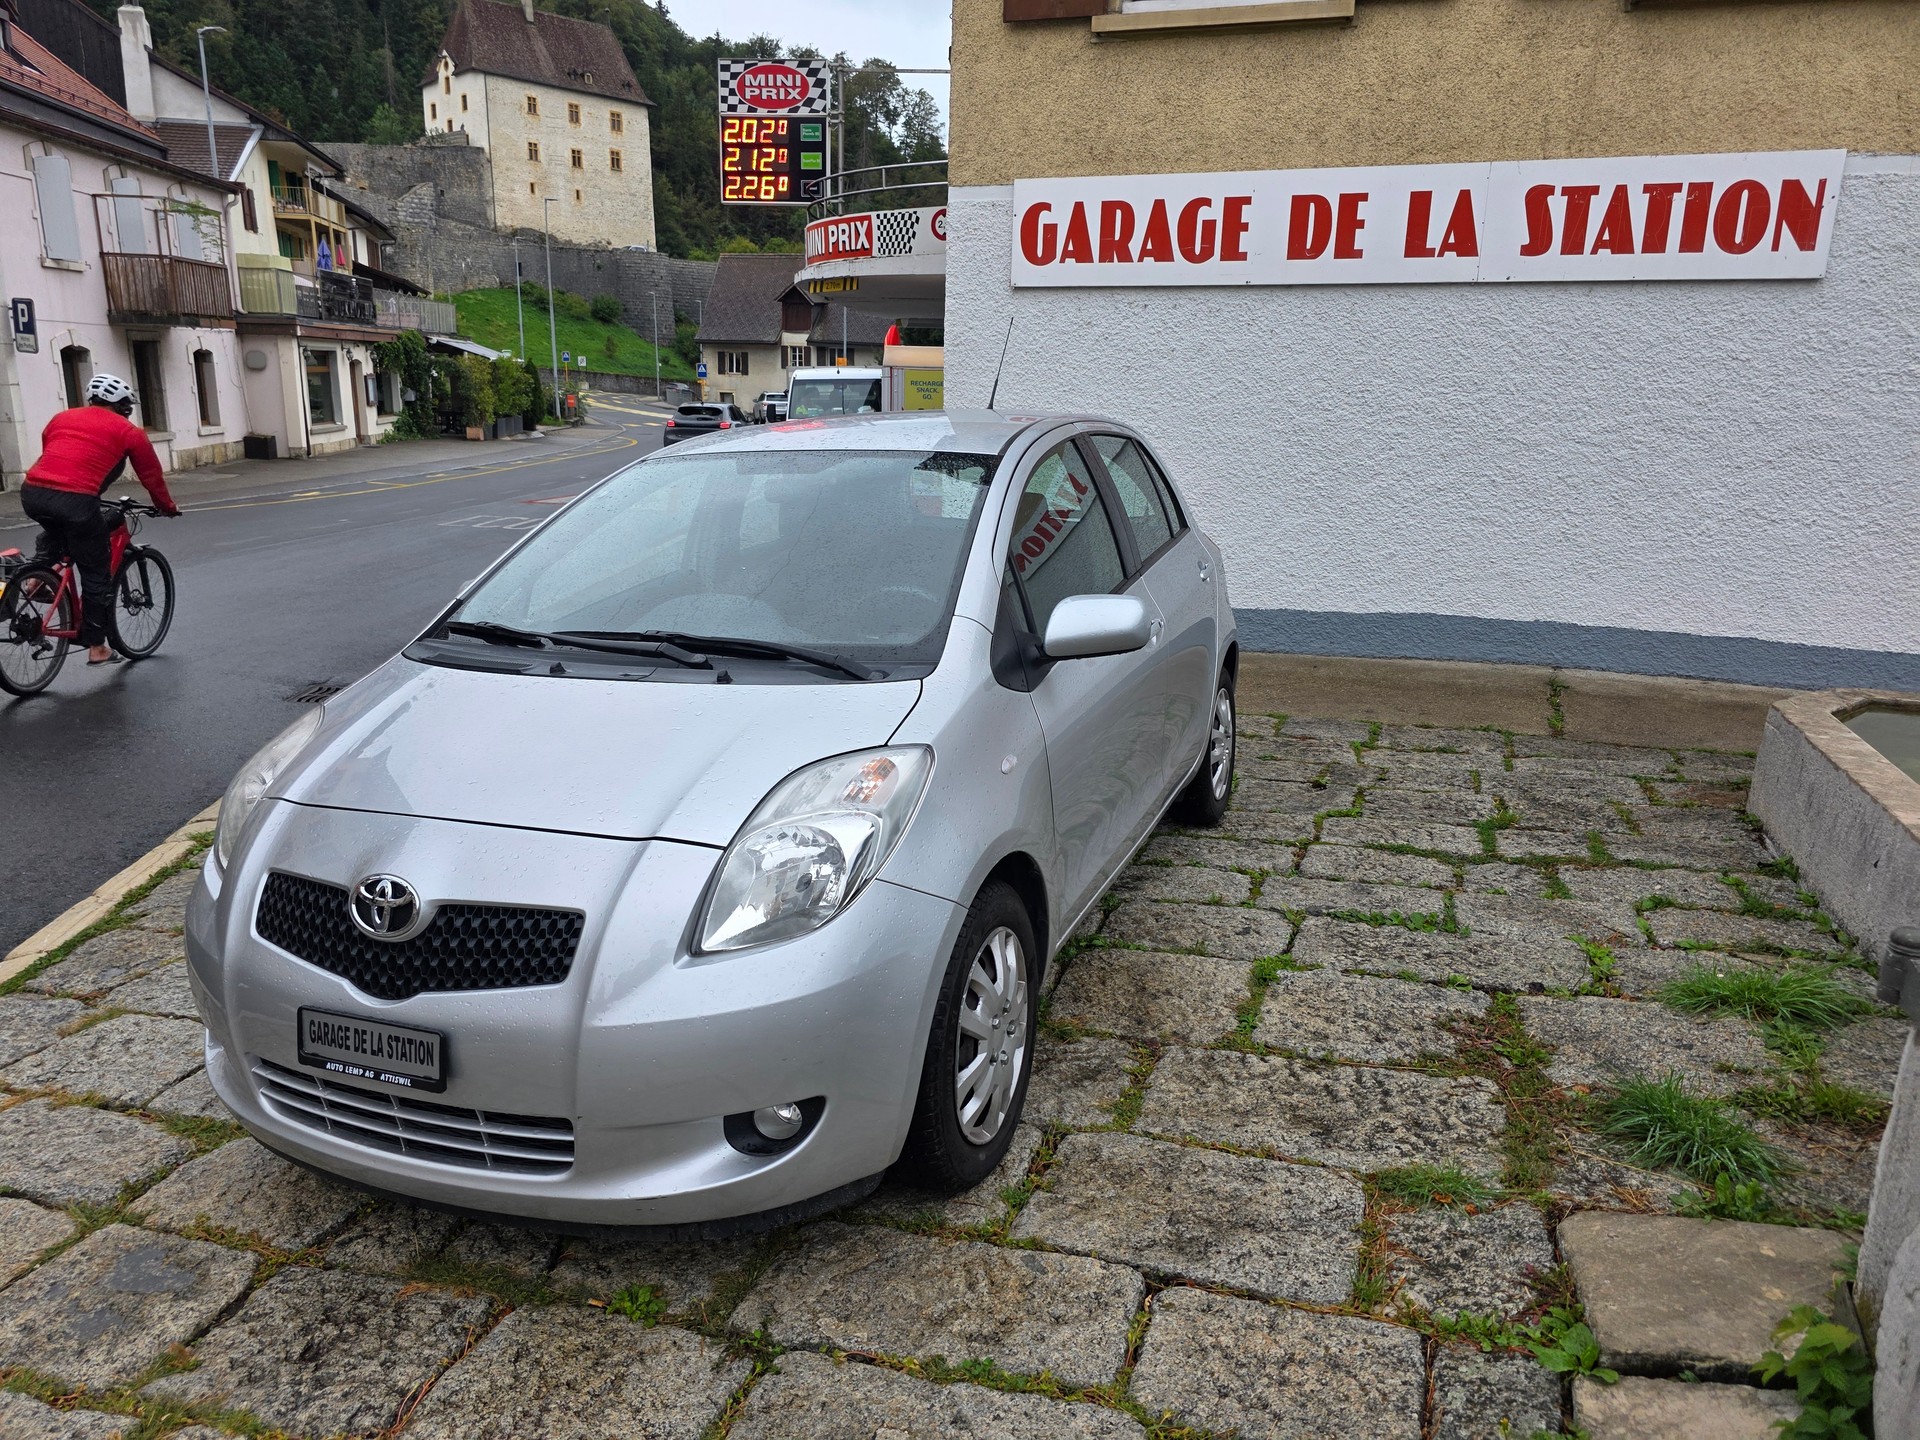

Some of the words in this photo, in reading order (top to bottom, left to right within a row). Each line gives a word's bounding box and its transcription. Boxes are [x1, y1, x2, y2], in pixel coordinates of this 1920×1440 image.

[744, 74, 802, 87] MINI
[744, 87, 802, 100] PRIX
[1020, 195, 1253, 267] GARAGE
[1286, 192, 1369, 260] DE
[1403, 189, 1480, 259] LA
[1519, 178, 1828, 257] STATION
[807, 227, 826, 258] MINI
[828, 220, 870, 254] PRIX
[17, 303, 29, 331] P
[309, 1019, 351, 1051] GARAGE
[353, 1028, 368, 1054] DE
[370, 1031, 385, 1058] LA
[387, 1034, 435, 1067] STATION
[326, 1062, 344, 1072] AUTO
[345, 1065, 364, 1076] LEMP
[364, 1070, 375, 1079] AG
[380, 1073, 412, 1087] ATTISWIL
